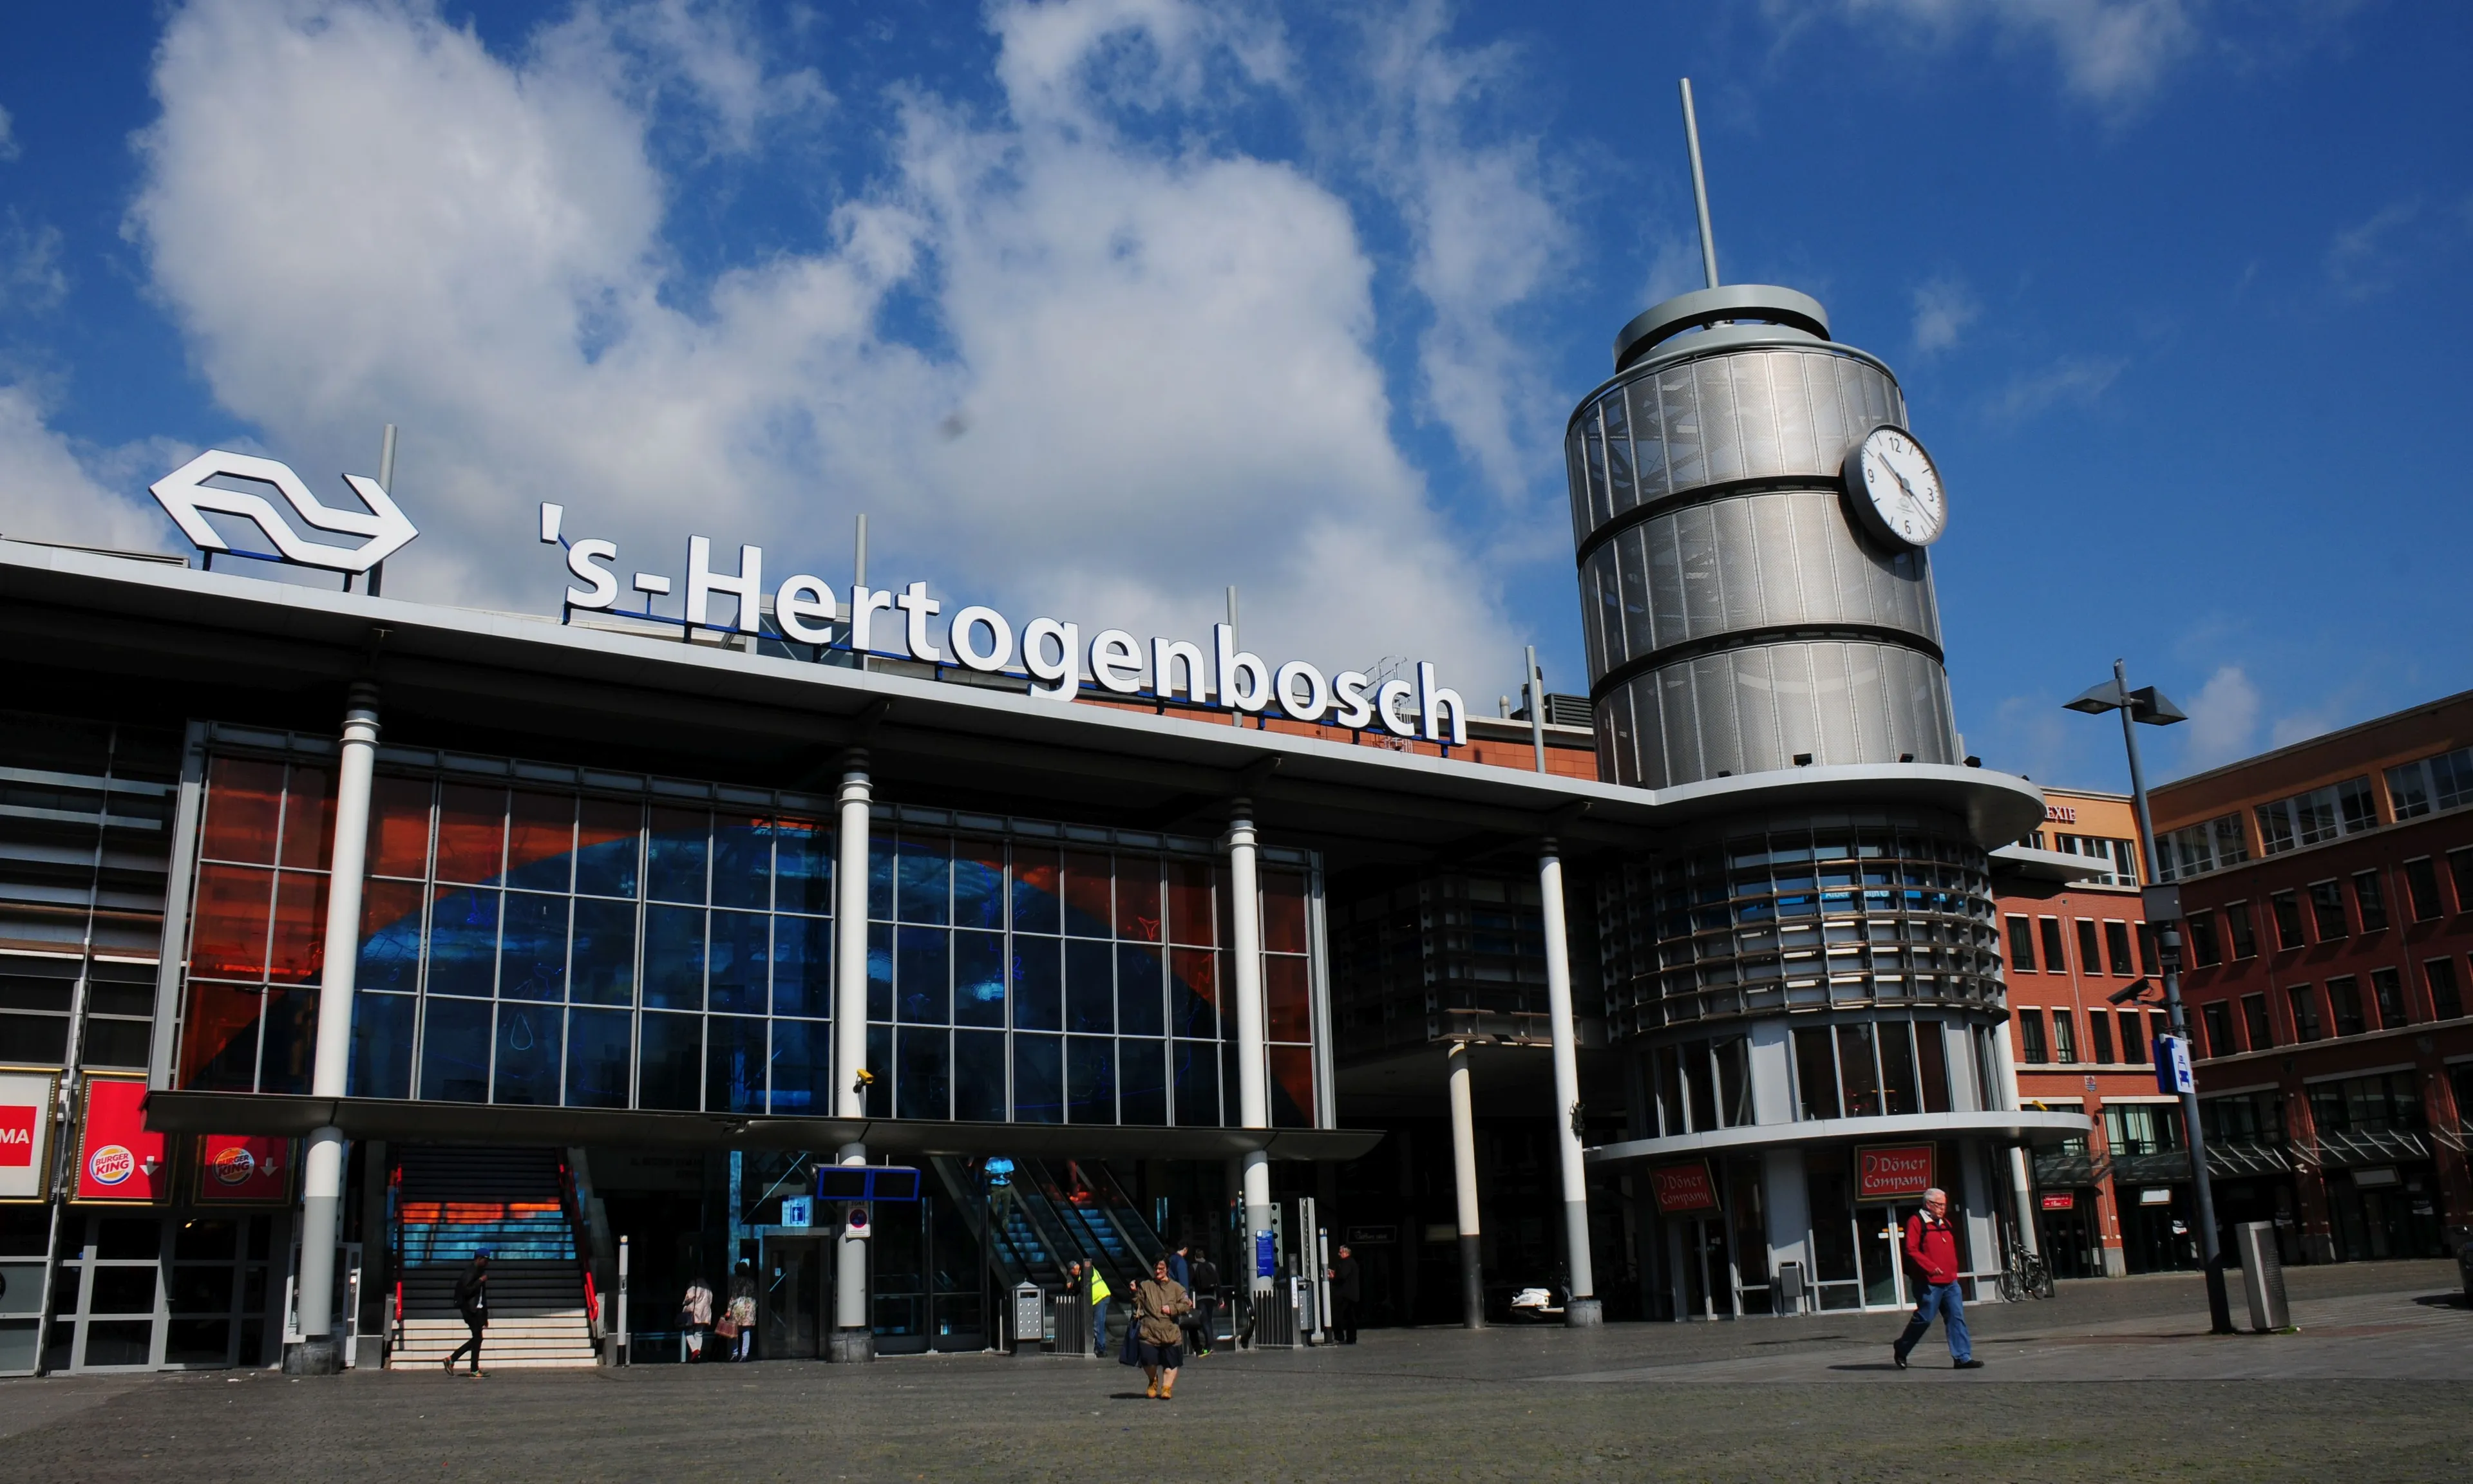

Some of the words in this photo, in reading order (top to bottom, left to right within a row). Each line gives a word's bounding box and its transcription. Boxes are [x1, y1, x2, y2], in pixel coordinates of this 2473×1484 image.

[1889, 437, 1901, 453] 12
[1868, 469, 1875, 484] 9
[1927, 487, 1935, 502] 3
[1904, 520, 1911, 534] 6
[540, 501, 1468, 746] 's-Hertogenbosch
[95, 1153, 129, 1166] BURGER
[218, 1154, 249, 1165] BURGER
[1879, 1157, 1926, 1172] Döner
[96, 1160, 129, 1176] KING
[219, 1161, 250, 1176] KING
[1667, 1174, 1703, 1190] Döner
[1864, 1174, 1928, 1190] Company
[1660, 1190, 1709, 1206] Company
